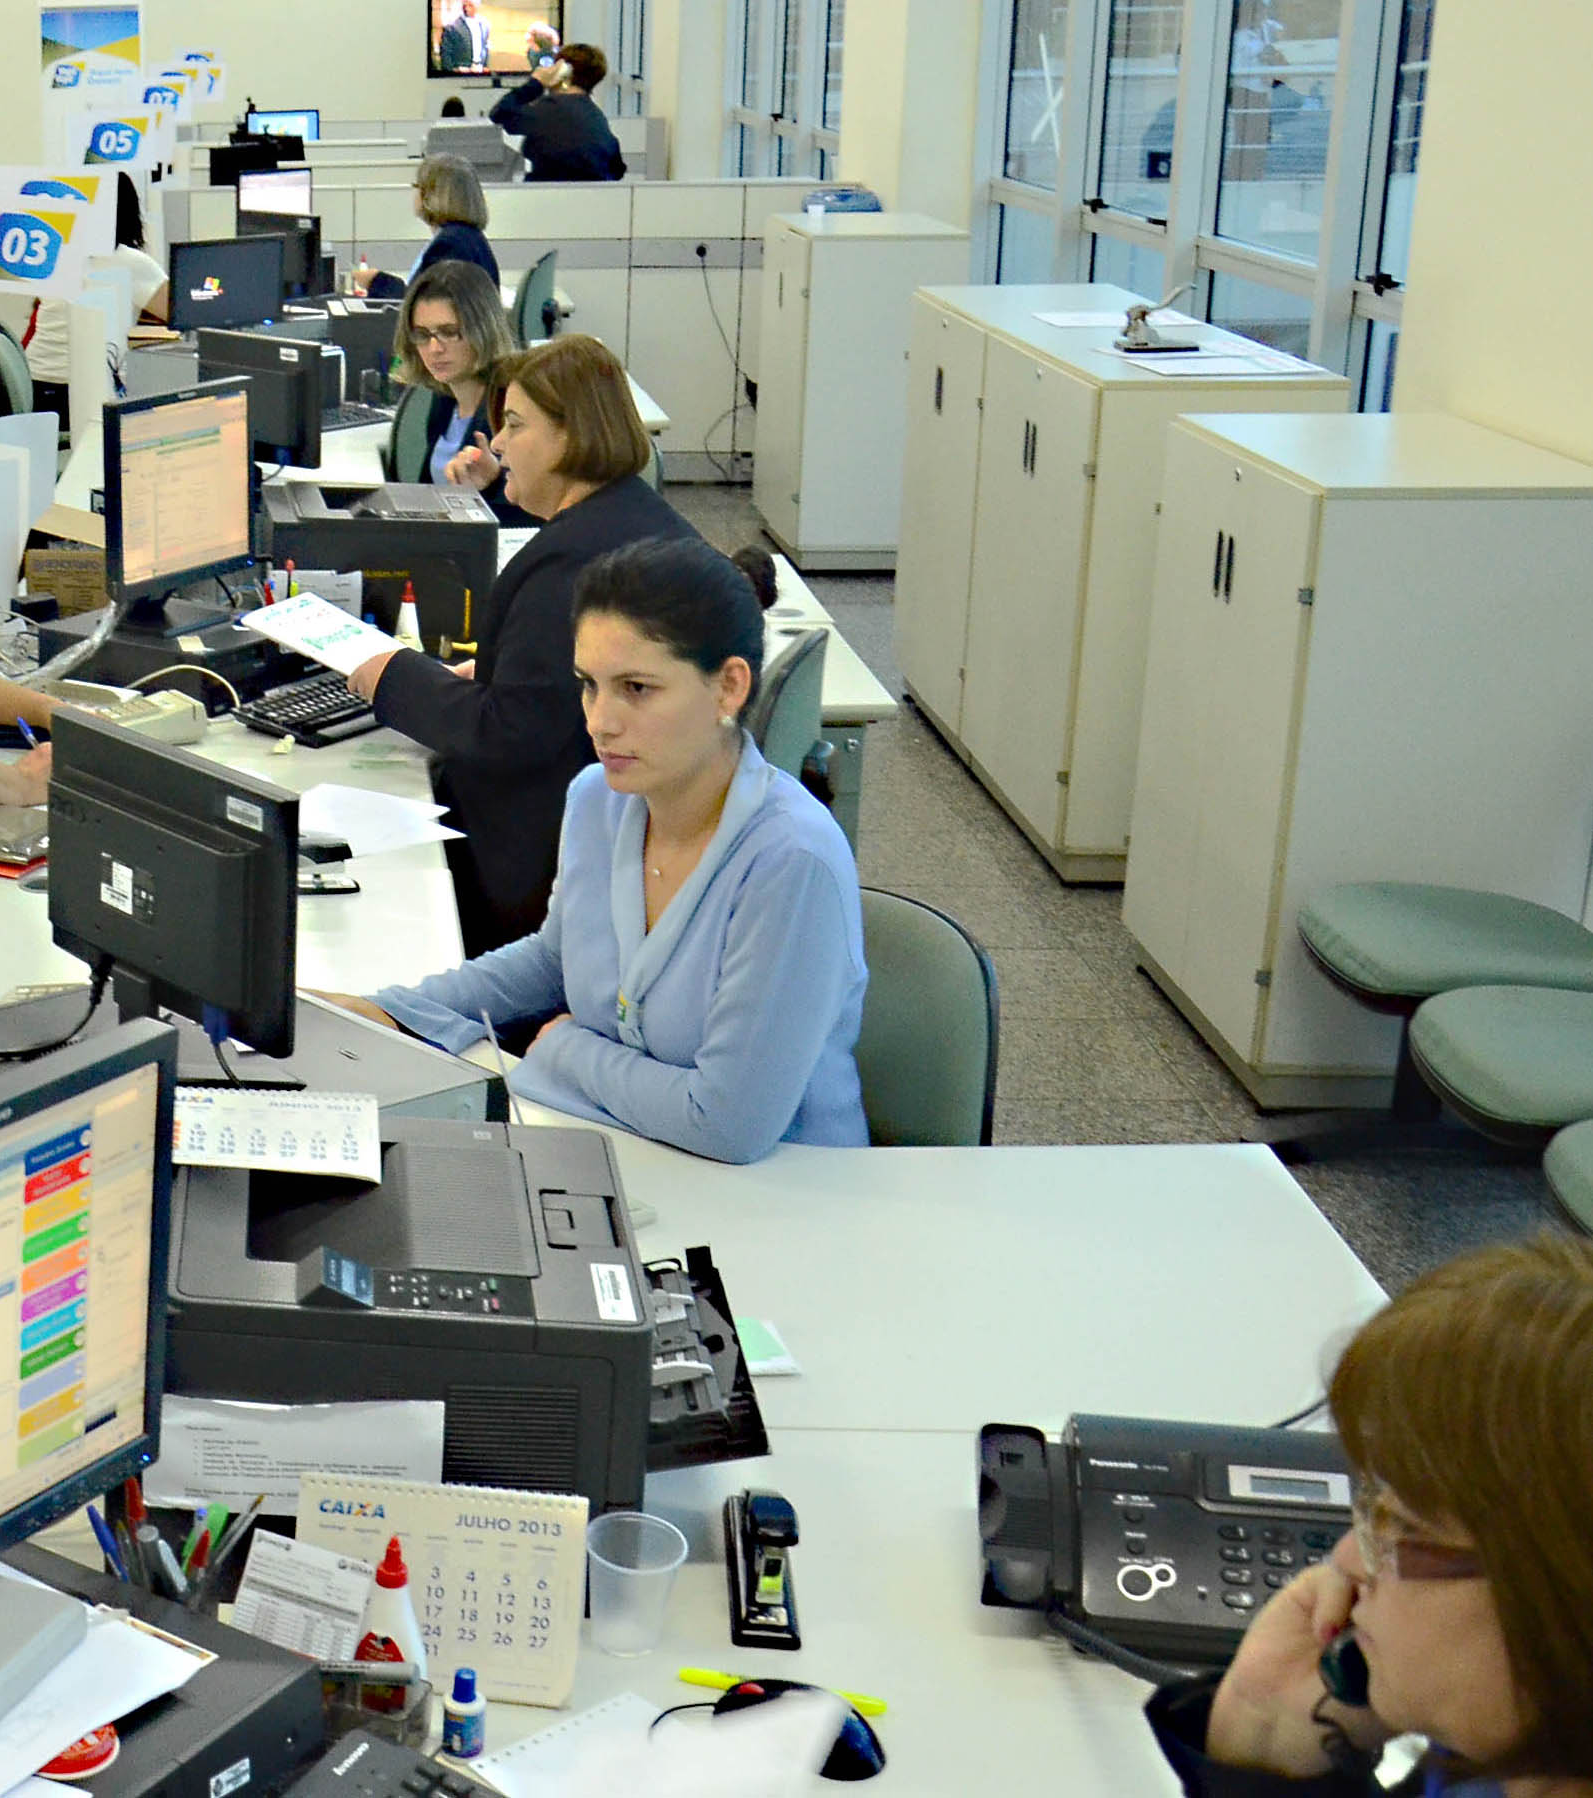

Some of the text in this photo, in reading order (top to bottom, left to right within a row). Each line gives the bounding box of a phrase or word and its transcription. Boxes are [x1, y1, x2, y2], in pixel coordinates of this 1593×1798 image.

[99, 129, 133, 155] 05
[1, 227, 51, 266] 03
[319, 1499, 386, 1520] CAIXA
[455, 1514, 562, 1538] JULHO 2013
[431, 1567, 548, 1591] 3 4 5 6
[426, 1585, 551, 1611] 10 11 12 13
[425, 1605, 551, 1630] 17 18 19 20
[423, 1625, 548, 1649] 24 25 26 27
